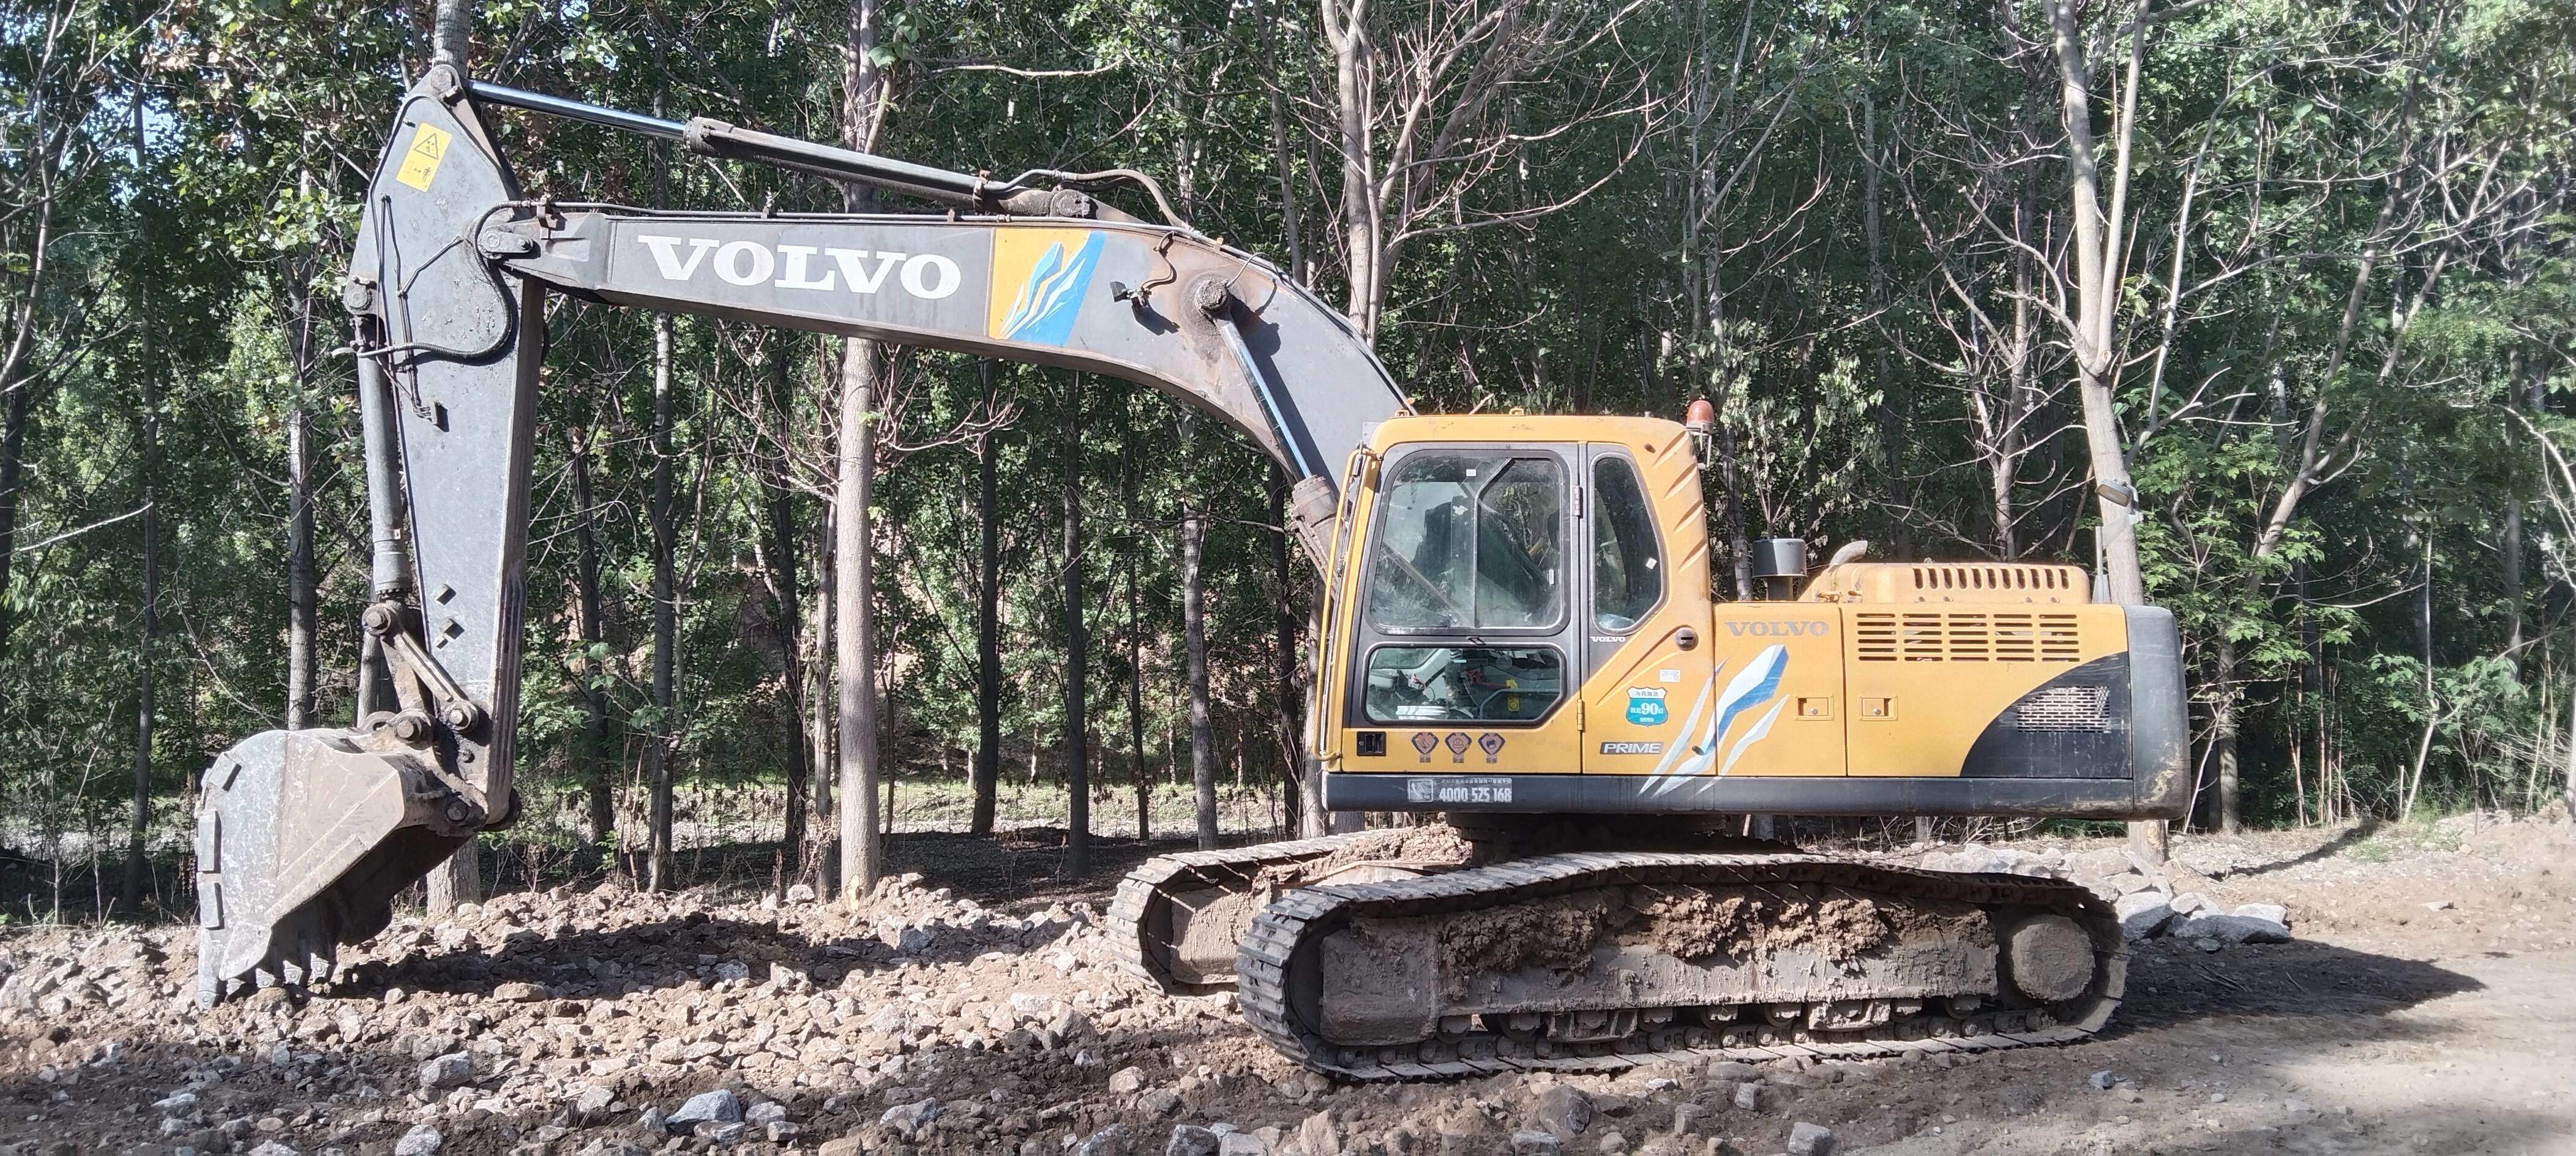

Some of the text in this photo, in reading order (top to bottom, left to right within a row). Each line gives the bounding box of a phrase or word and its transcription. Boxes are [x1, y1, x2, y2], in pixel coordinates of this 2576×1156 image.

[637, 235, 962, 299] VOLVO
[1724, 621, 1829, 636] VOLVO
[1604, 743, 1661, 753] PRIME
[1439, 787, 1512, 802] 4000 525 168
